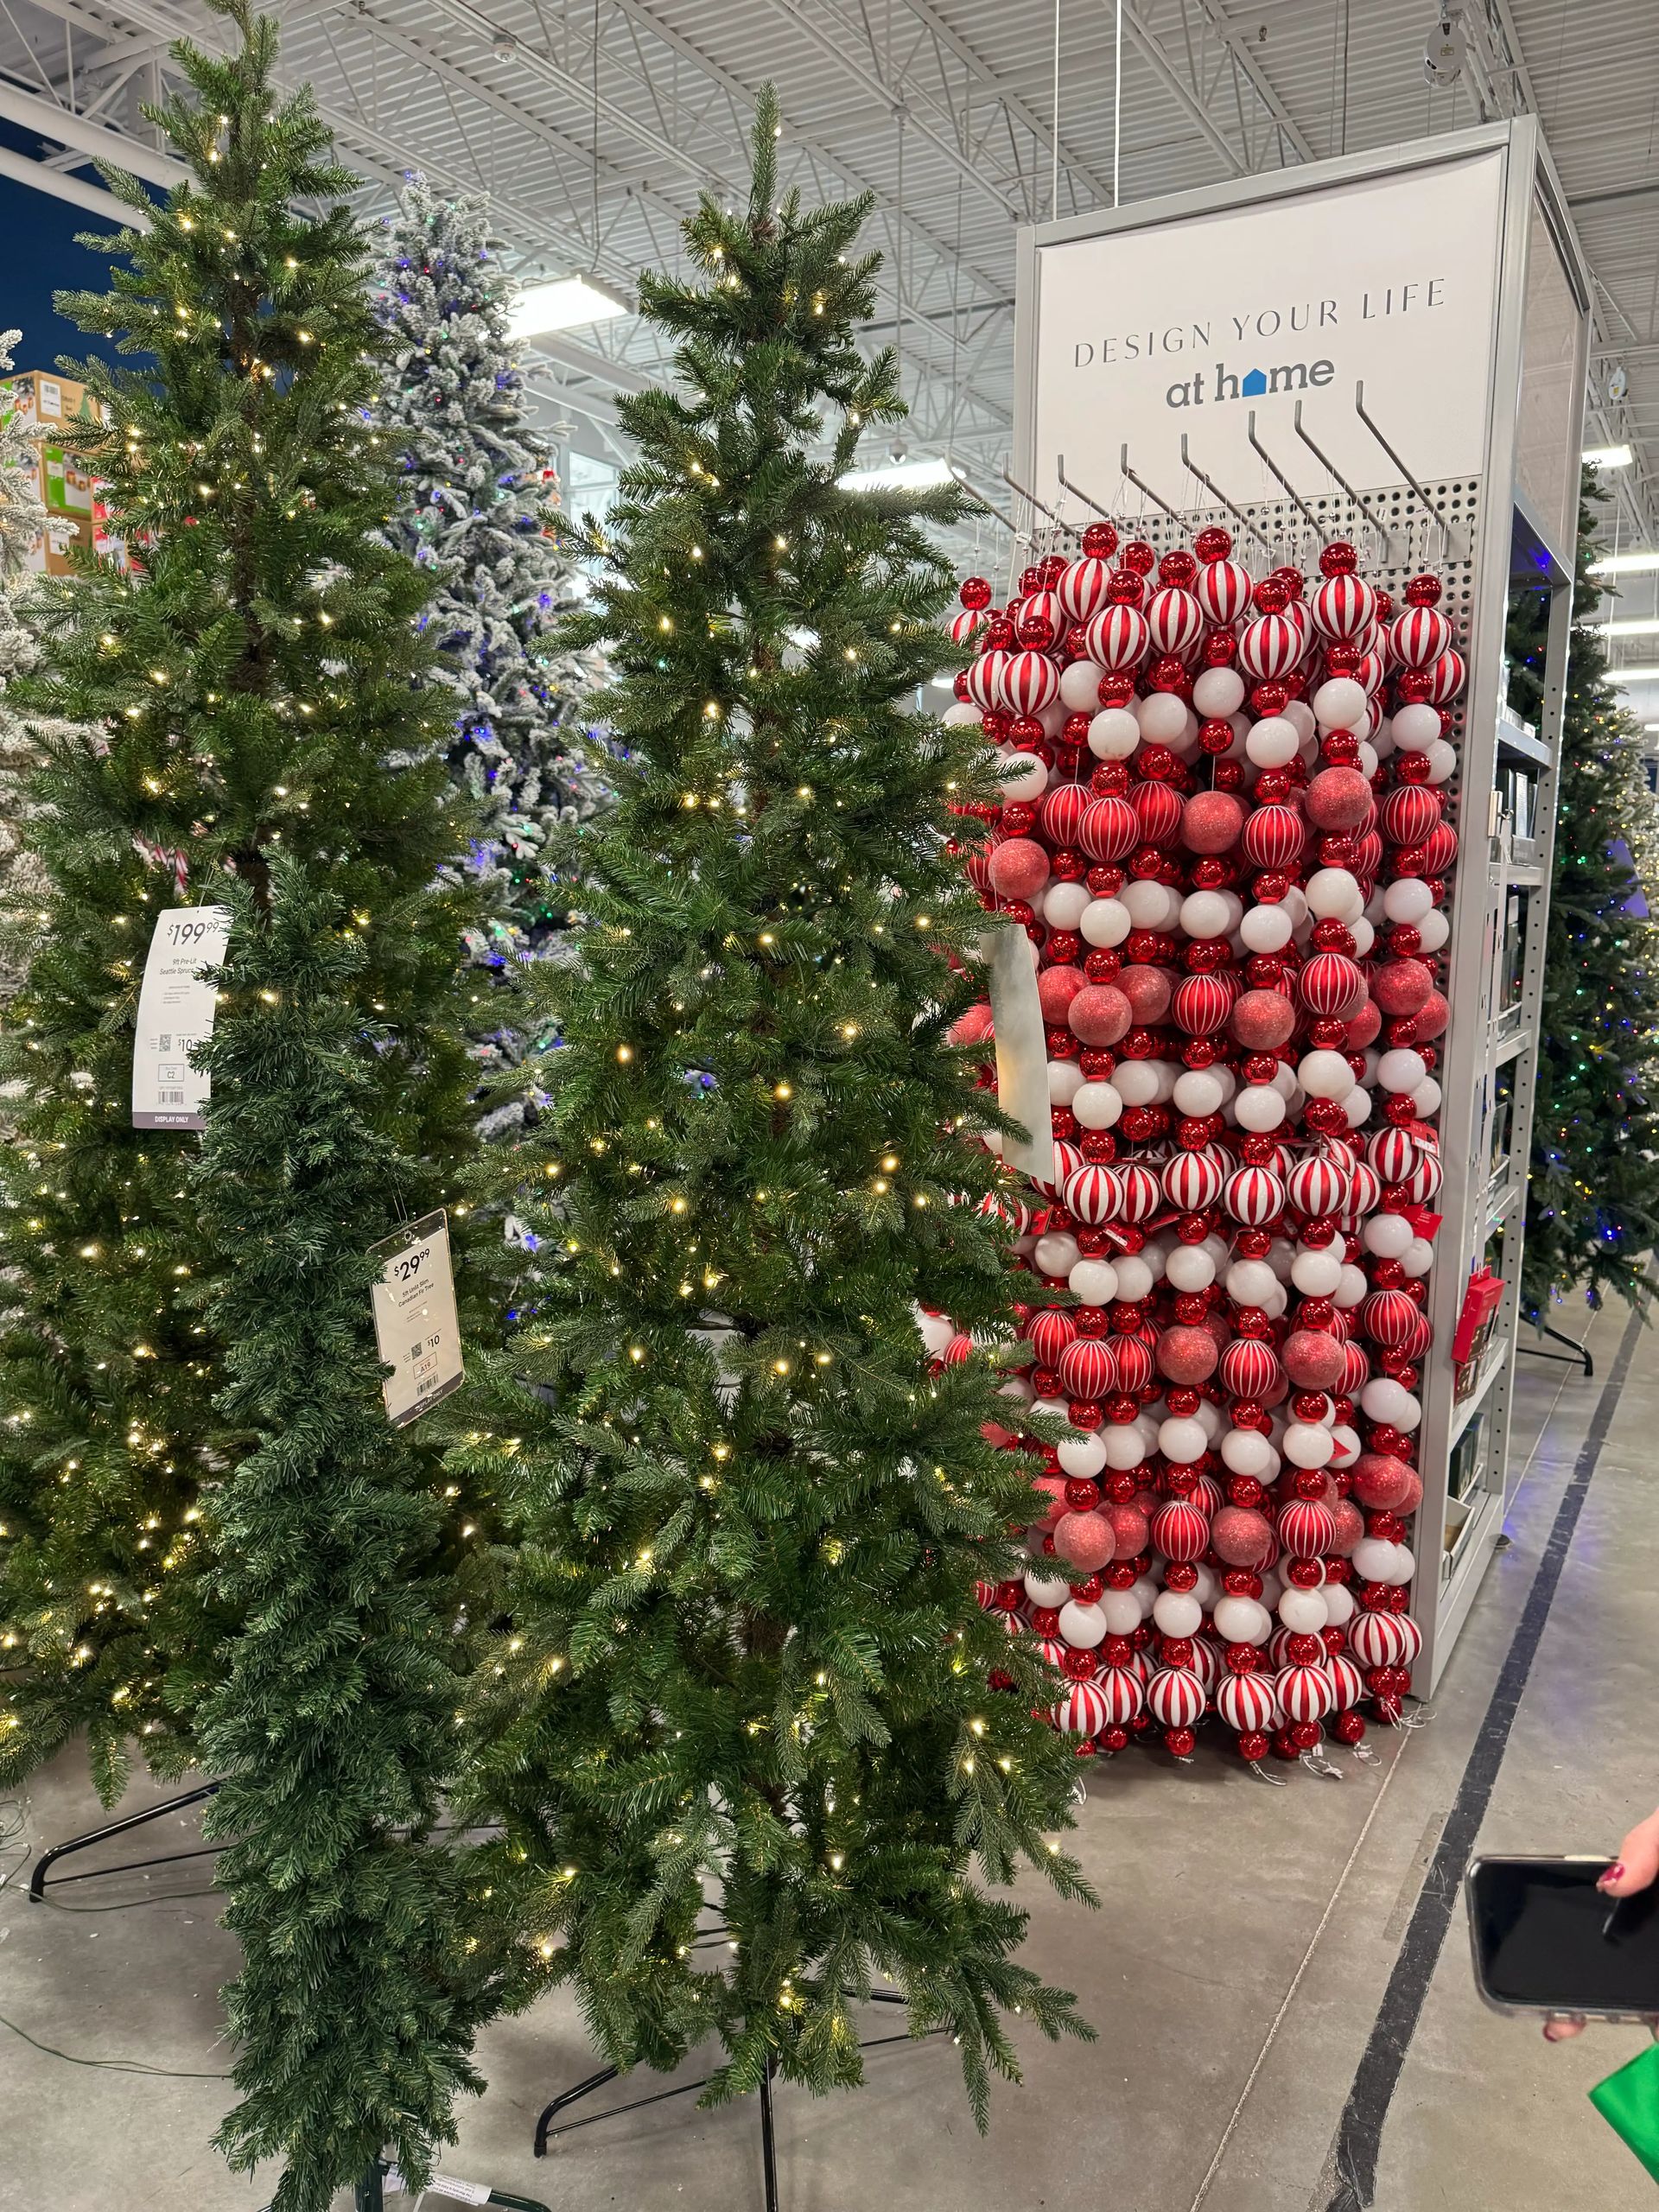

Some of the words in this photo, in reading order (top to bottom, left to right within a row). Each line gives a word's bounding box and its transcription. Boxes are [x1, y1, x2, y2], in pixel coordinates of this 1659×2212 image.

[1074, 321, 1211, 368] DESIGN
[1231, 300, 1339, 341] YOUR
[1362, 277, 1446, 320] LIFE
[1166, 372, 1204, 409] at
[178, 1039, 193, 1052] $10
[409, 1284, 420, 1294] Unlit
[419, 1279, 429, 1287] Slim
[398, 1293, 419, 1307] Canadian
[424, 1282, 435, 1292] Tree
[427, 1335, 440, 1348] $10
[420, 1361, 431, 1373] A19
